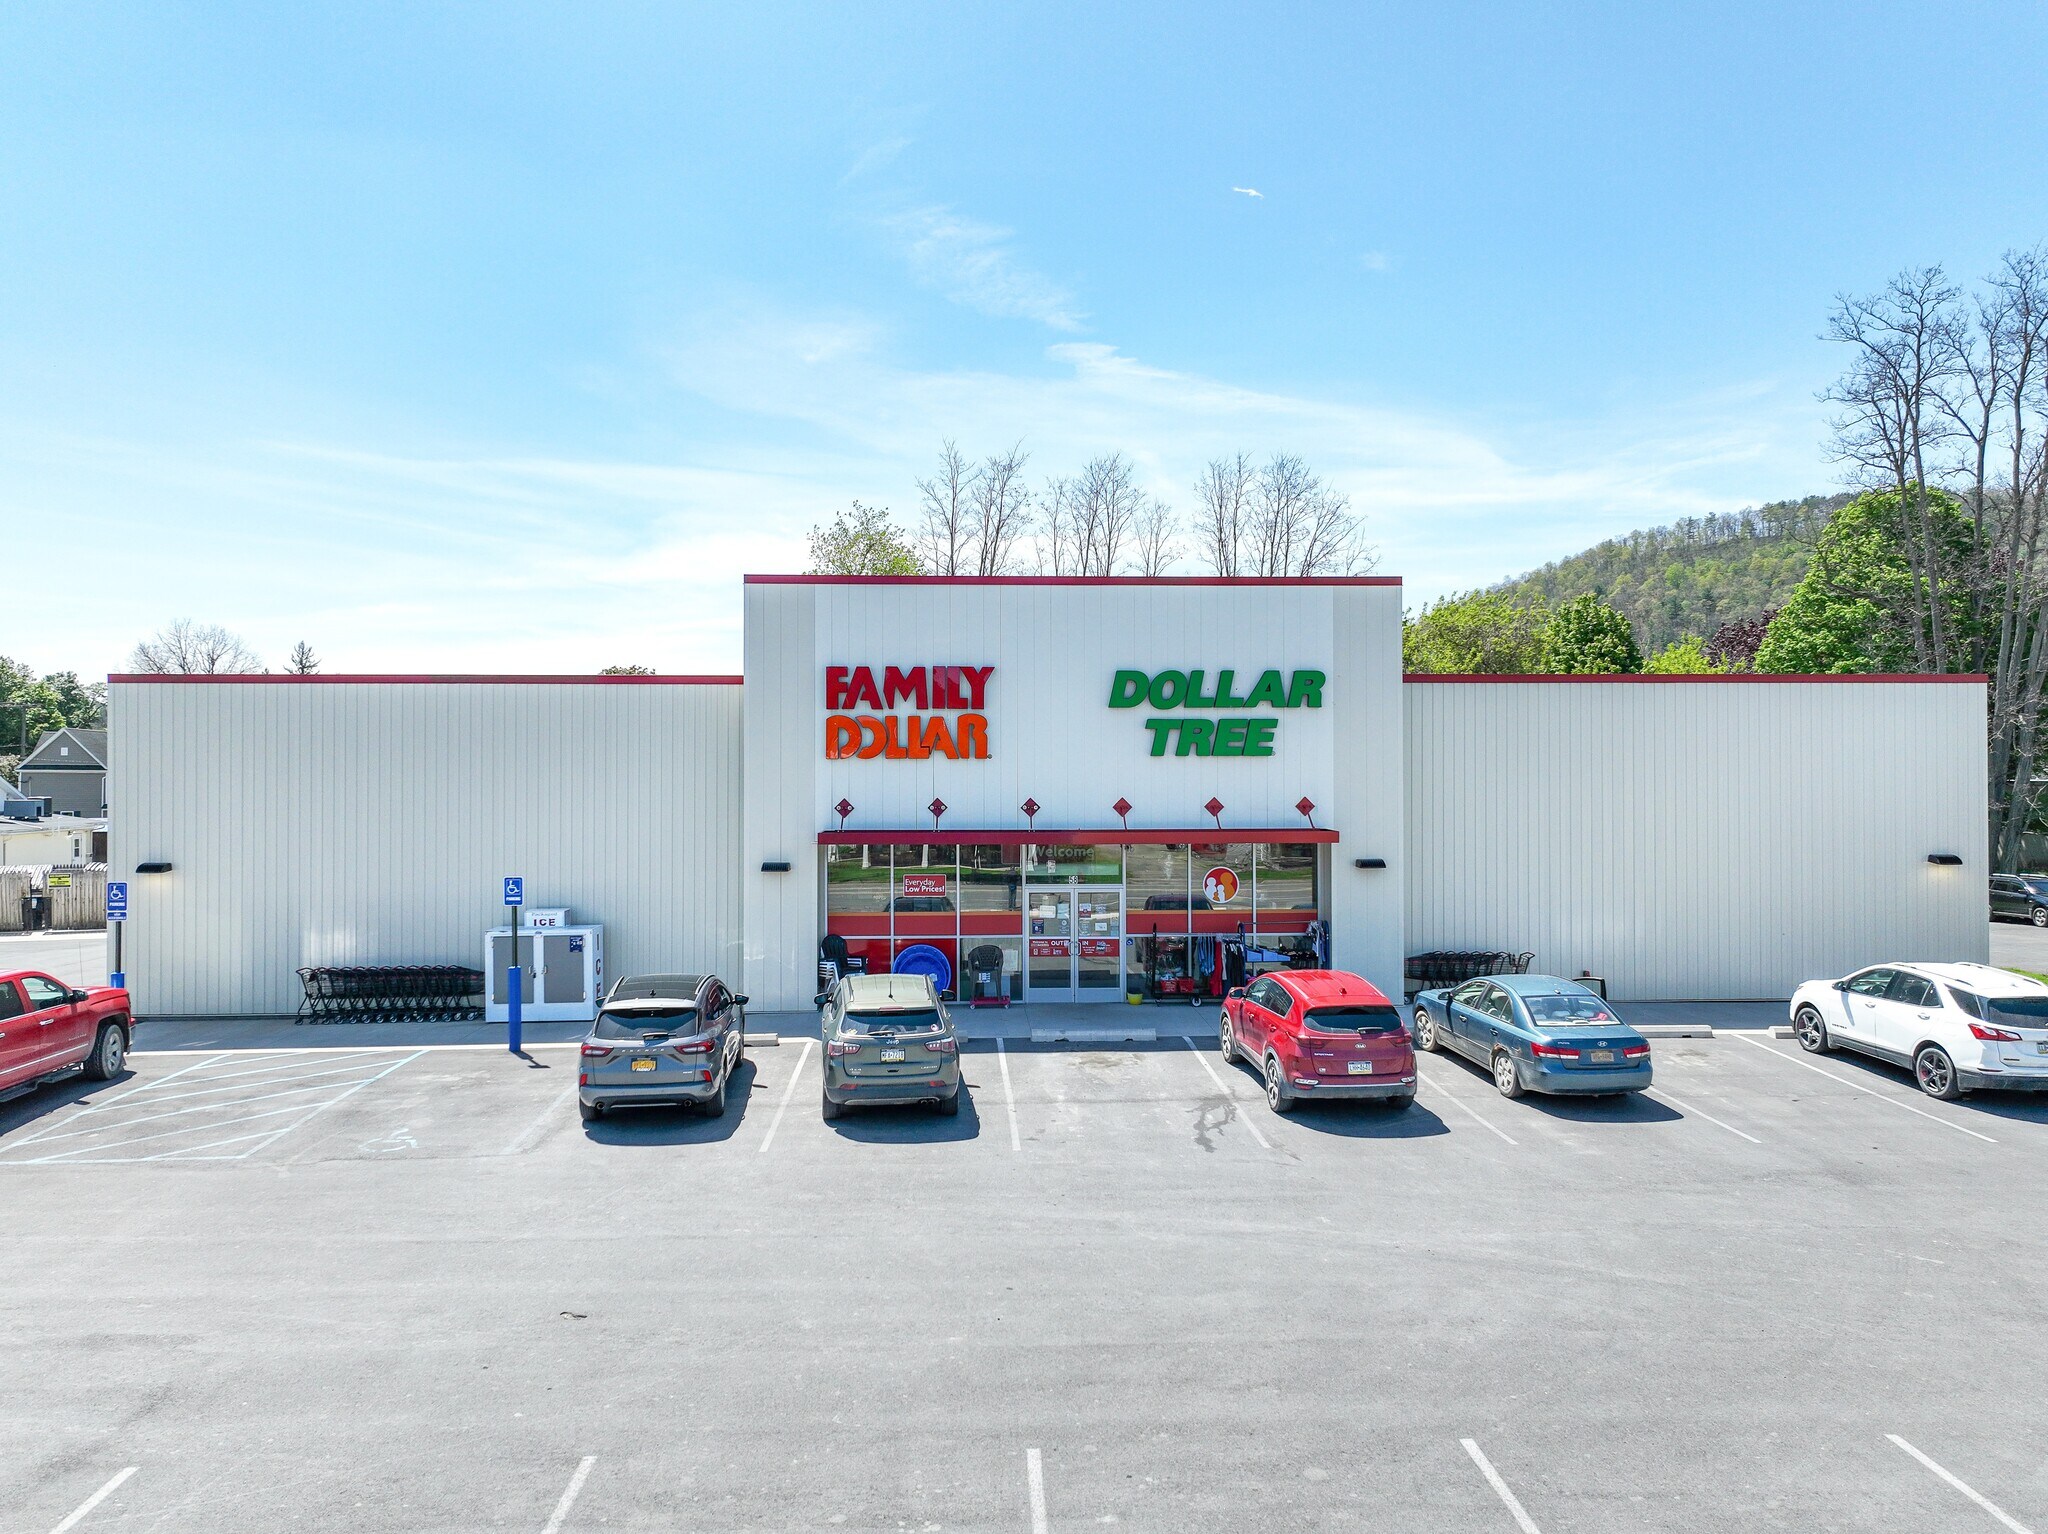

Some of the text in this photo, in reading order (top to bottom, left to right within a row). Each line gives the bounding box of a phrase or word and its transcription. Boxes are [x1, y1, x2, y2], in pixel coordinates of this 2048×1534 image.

[826, 666, 995, 709] FAMILY
[1108, 670, 1326, 710] DOLLAR
[826, 713, 990, 759] DOLLAR
[1145, 718, 1279, 756] TREE
[1036, 845, 1095, 857] Welcome
[905, 878, 935, 887] Everyday
[1069, 876, 1078, 884] 58
[533, 918, 556, 926] ICE
